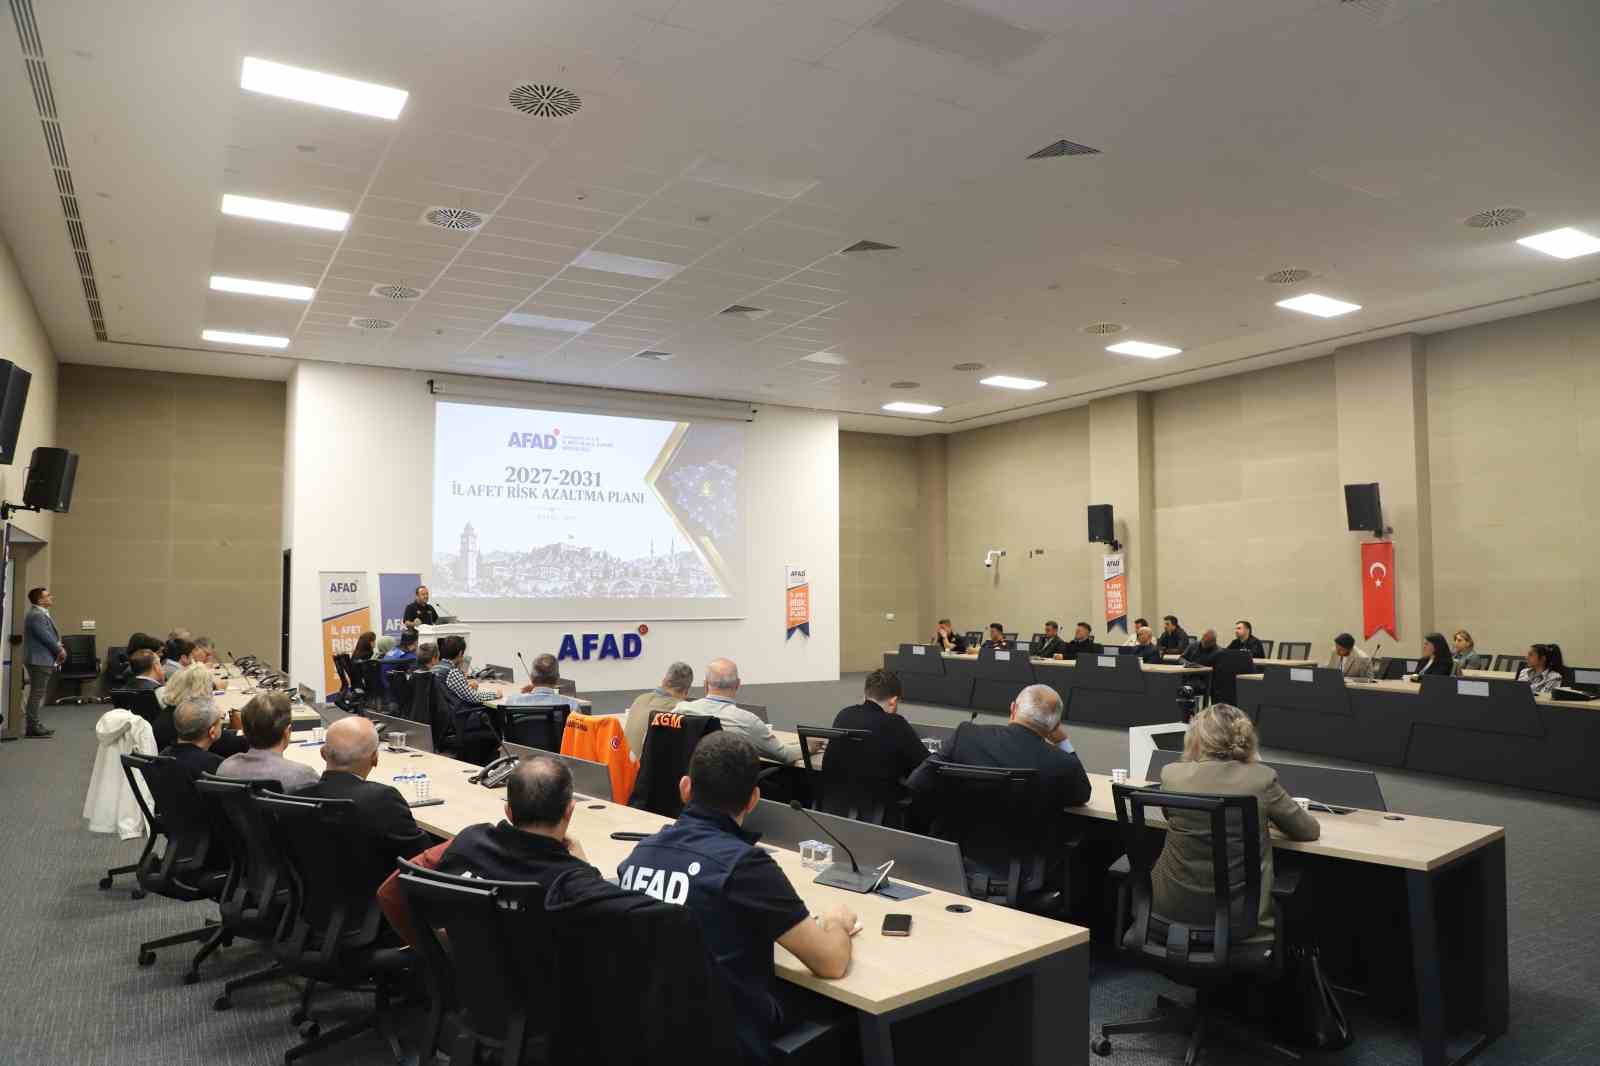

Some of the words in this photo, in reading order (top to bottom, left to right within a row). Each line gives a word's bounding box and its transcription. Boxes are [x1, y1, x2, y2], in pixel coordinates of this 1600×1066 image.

[508, 432, 557, 449] AFAD
[504, 466, 601, 487] 2027-2031
[452, 480, 464, 495] İL
[467, 485, 503, 496] AFET
[507, 484, 538, 499] RİSK
[542, 488, 604, 503] AZALTMA
[608, 491, 645, 504] PLANI
[330, 583, 357, 592] AFAD
[558, 633, 642, 660] AFAD
[651, 713, 683, 728] KGM
[620, 865, 689, 906] AFAD
